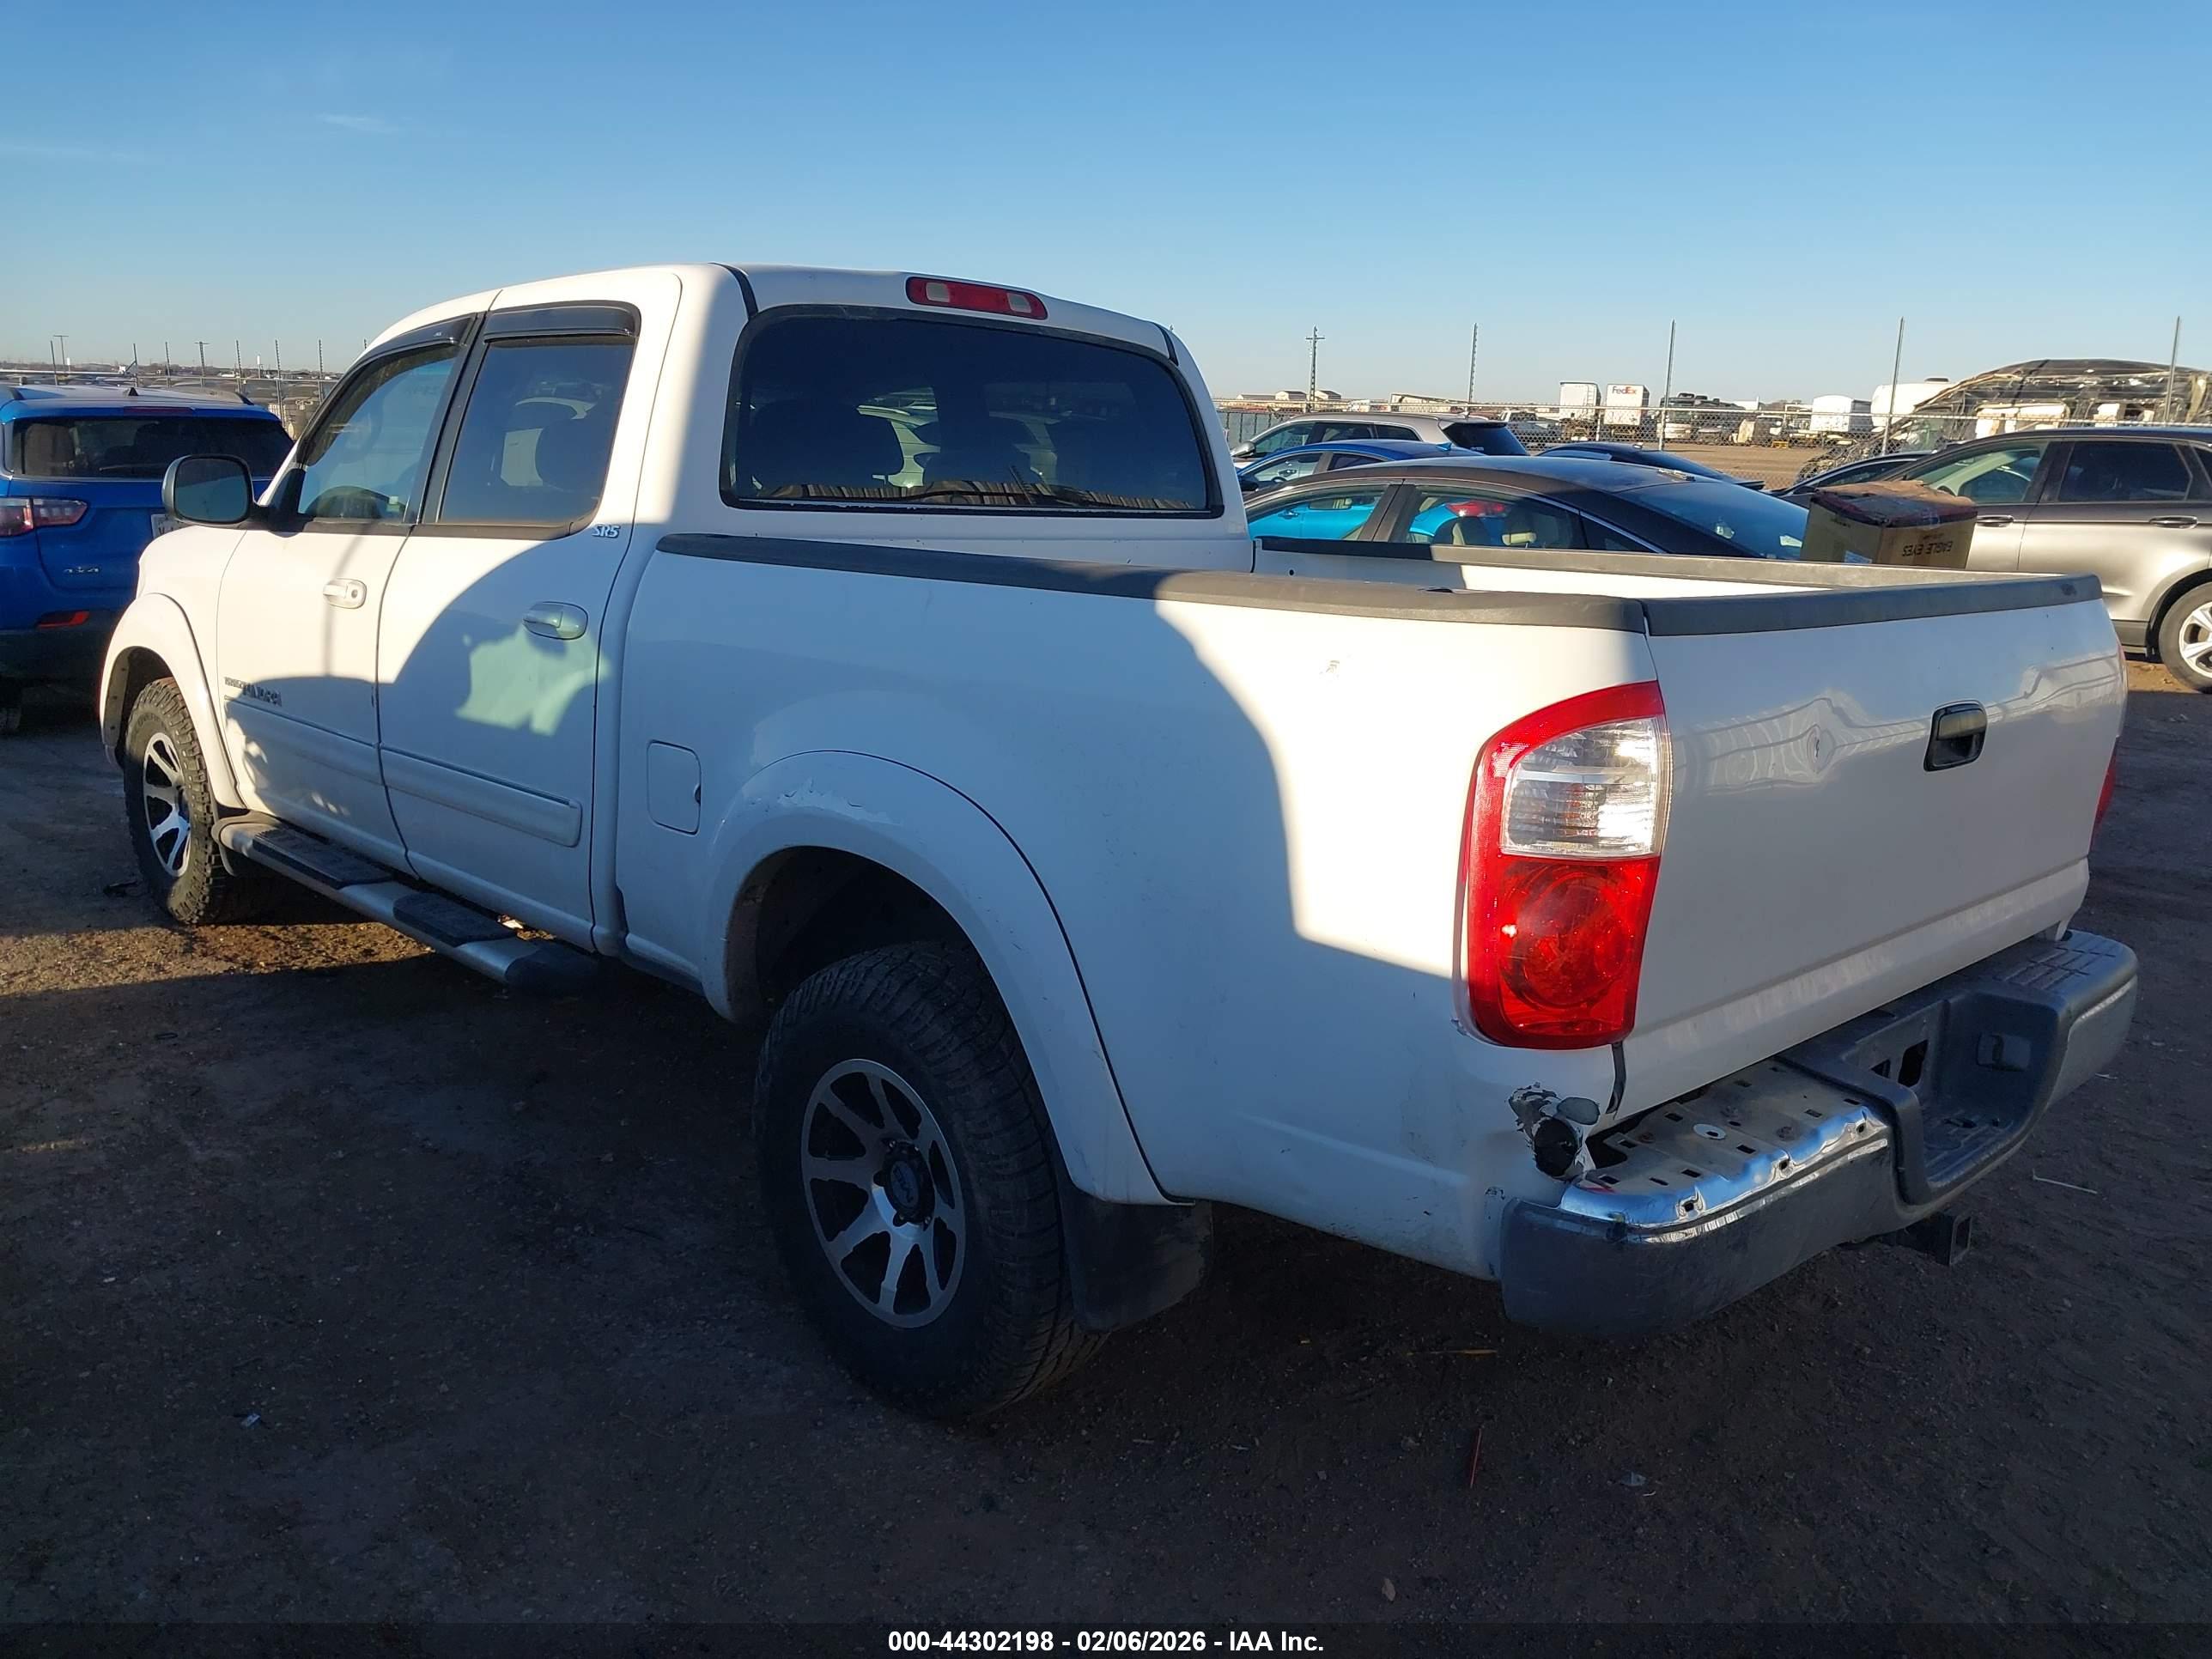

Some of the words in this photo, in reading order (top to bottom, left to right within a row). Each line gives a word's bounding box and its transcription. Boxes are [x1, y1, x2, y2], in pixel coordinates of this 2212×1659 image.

[1612, 386, 1638, 395] FedEx
[592, 524, 620, 538] SR5
[1901, 544, 1924, 557] EYES
[1925, 540, 1954, 555] EAGLE
